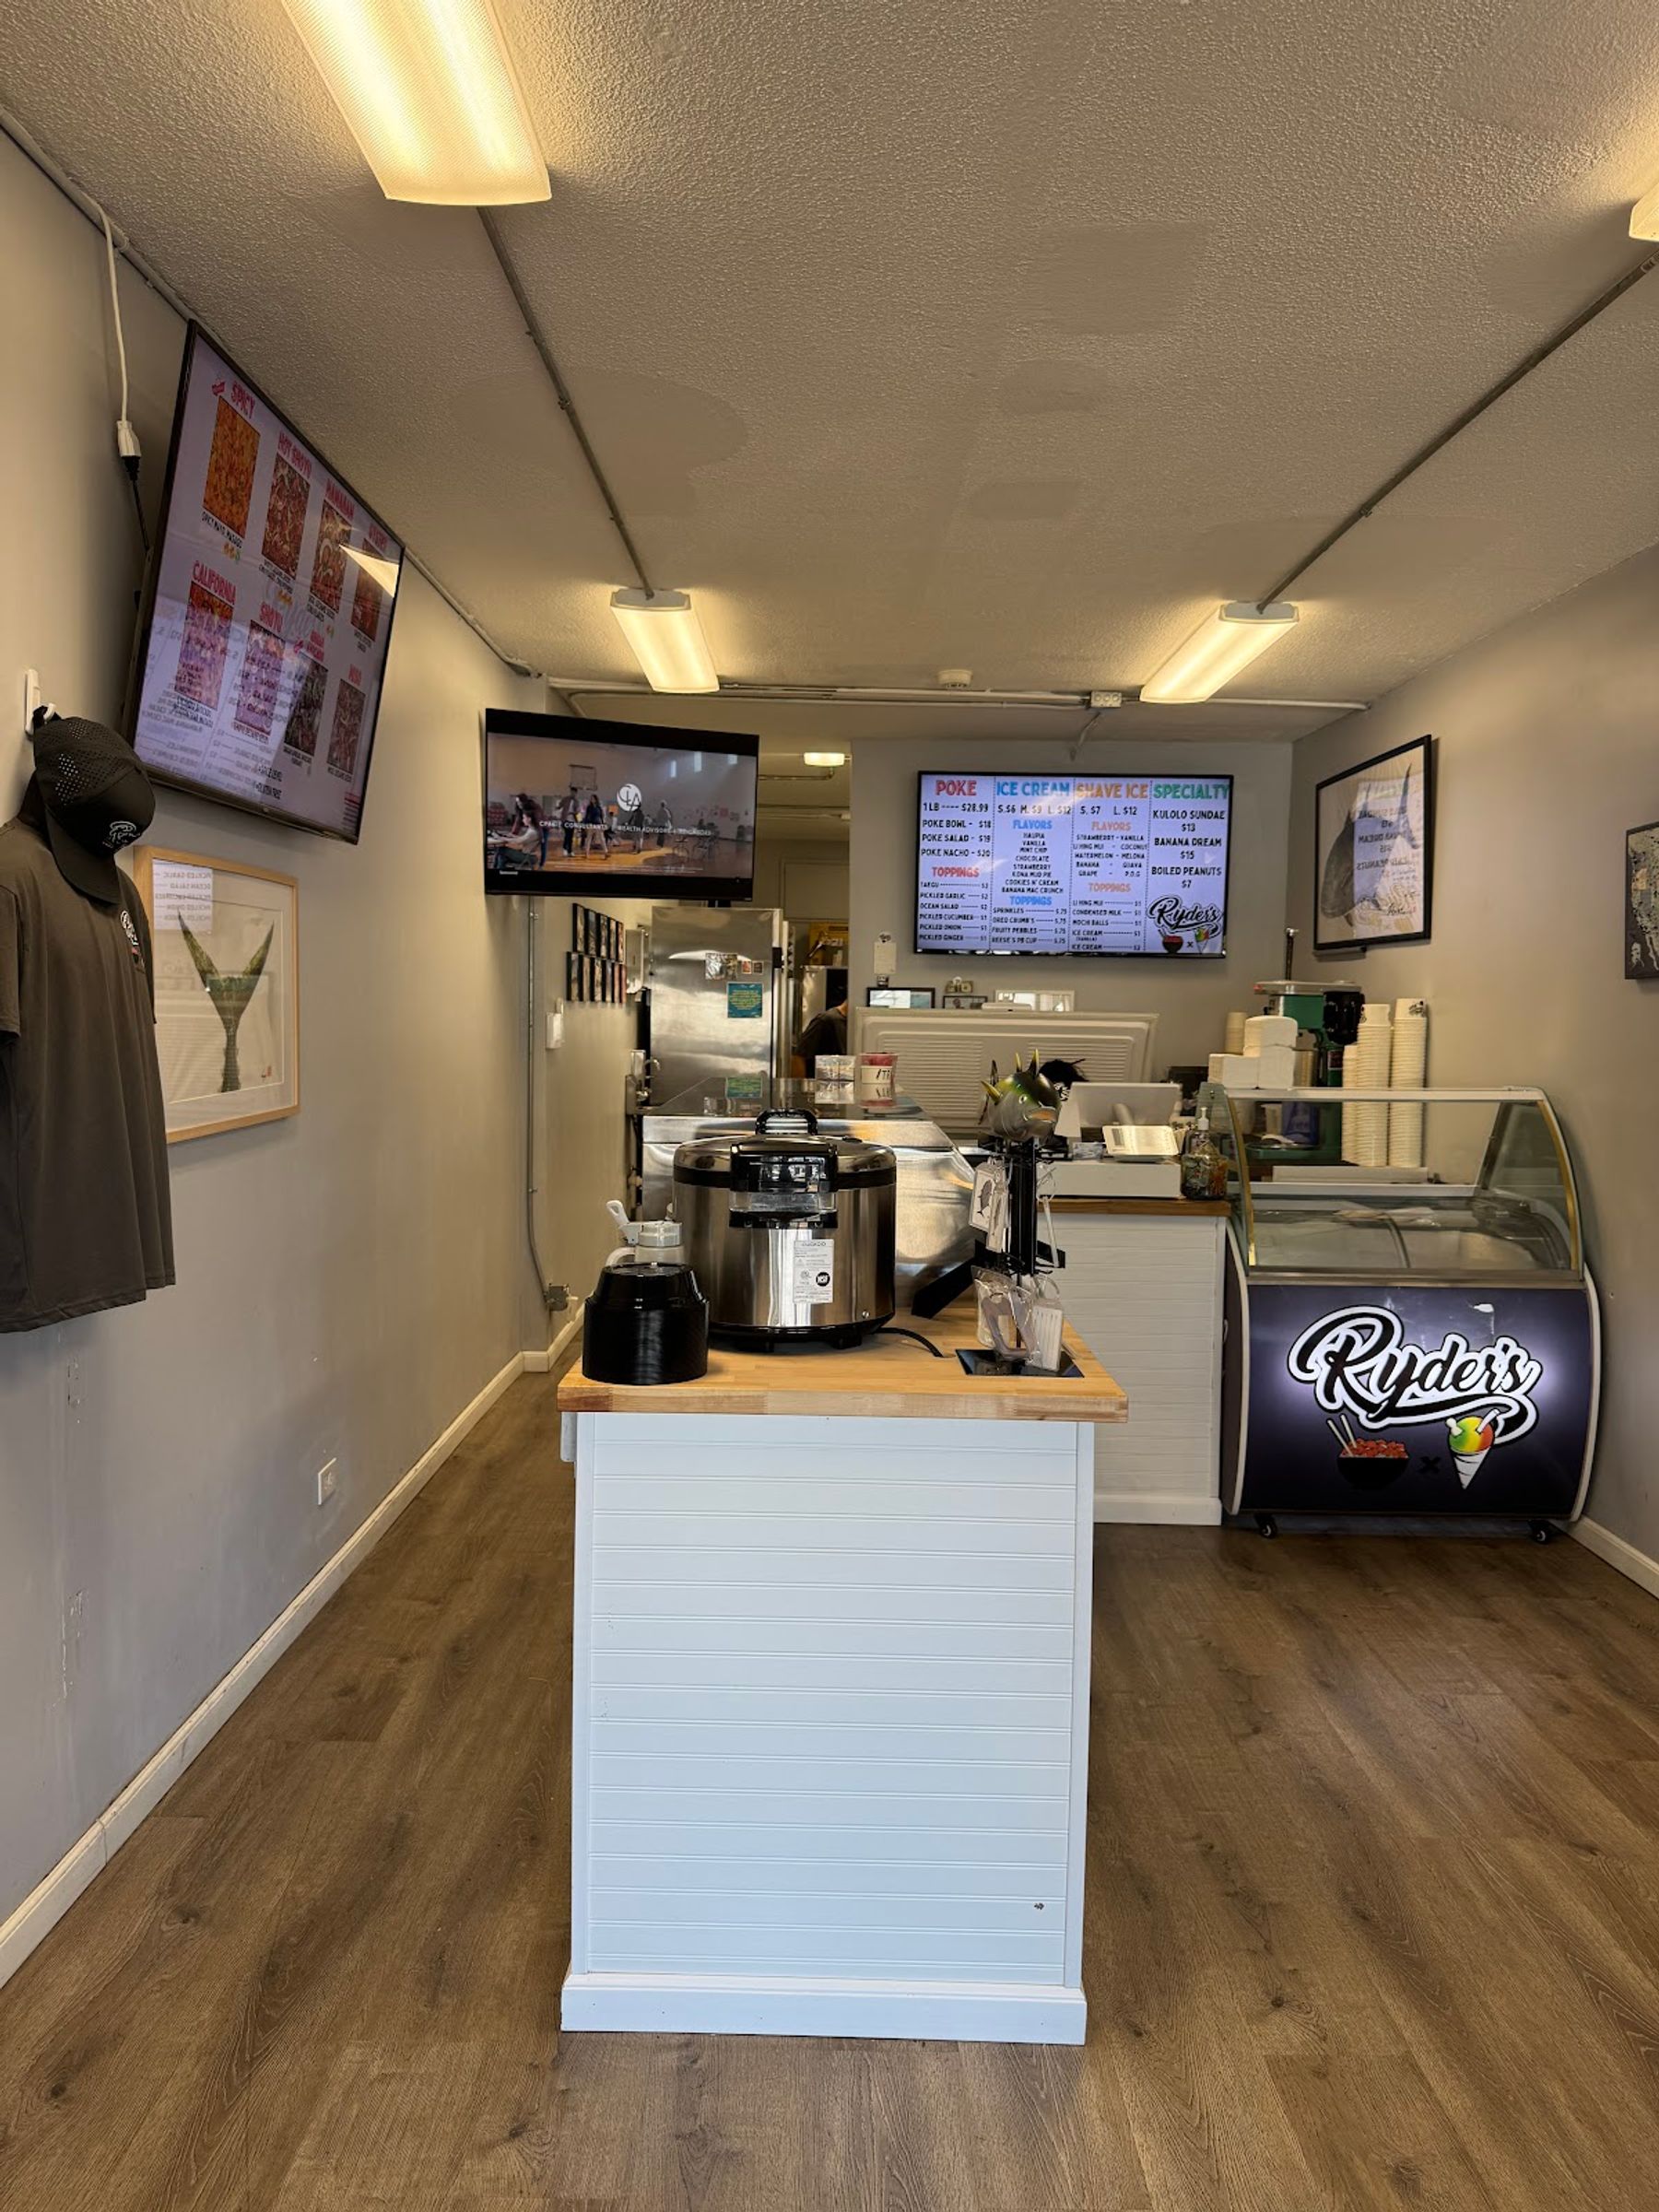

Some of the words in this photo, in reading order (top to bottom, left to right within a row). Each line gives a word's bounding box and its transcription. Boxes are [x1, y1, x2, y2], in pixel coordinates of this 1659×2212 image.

[935, 781, 976, 795] POKE
[996, 782, 1018, 795] ICE
[1022, 782, 1069, 796] CREAM
[1076, 783, 1122, 799] SHAVE
[1126, 784, 1148, 799] ICE
[1153, 783, 1229, 799] SPECIALTY
[961, 804, 988, 812] $28.99
[1123, 806, 1137, 815] $12
[1153, 810, 1187, 818] KULOLO
[1190, 810, 1224, 819] SUNDAE
[923, 819, 944, 828] POKE
[1013, 819, 1052, 830] FLAVORS
[1091, 821, 1132, 831] FLAVORS
[1155, 838, 1189, 846] BANANA
[1192, 838, 1221, 846] DREAM
[932, 867, 979, 877] TOPPINGS
[1184, 867, 1221, 876] PEANUTS
[1088, 883, 1131, 892] TOPPINGS
[1010, 896, 1052, 905] TOPPINGS
[1147, 896, 1223, 937] Ryder's
[1288, 1304, 1543, 1445] Ryder's
